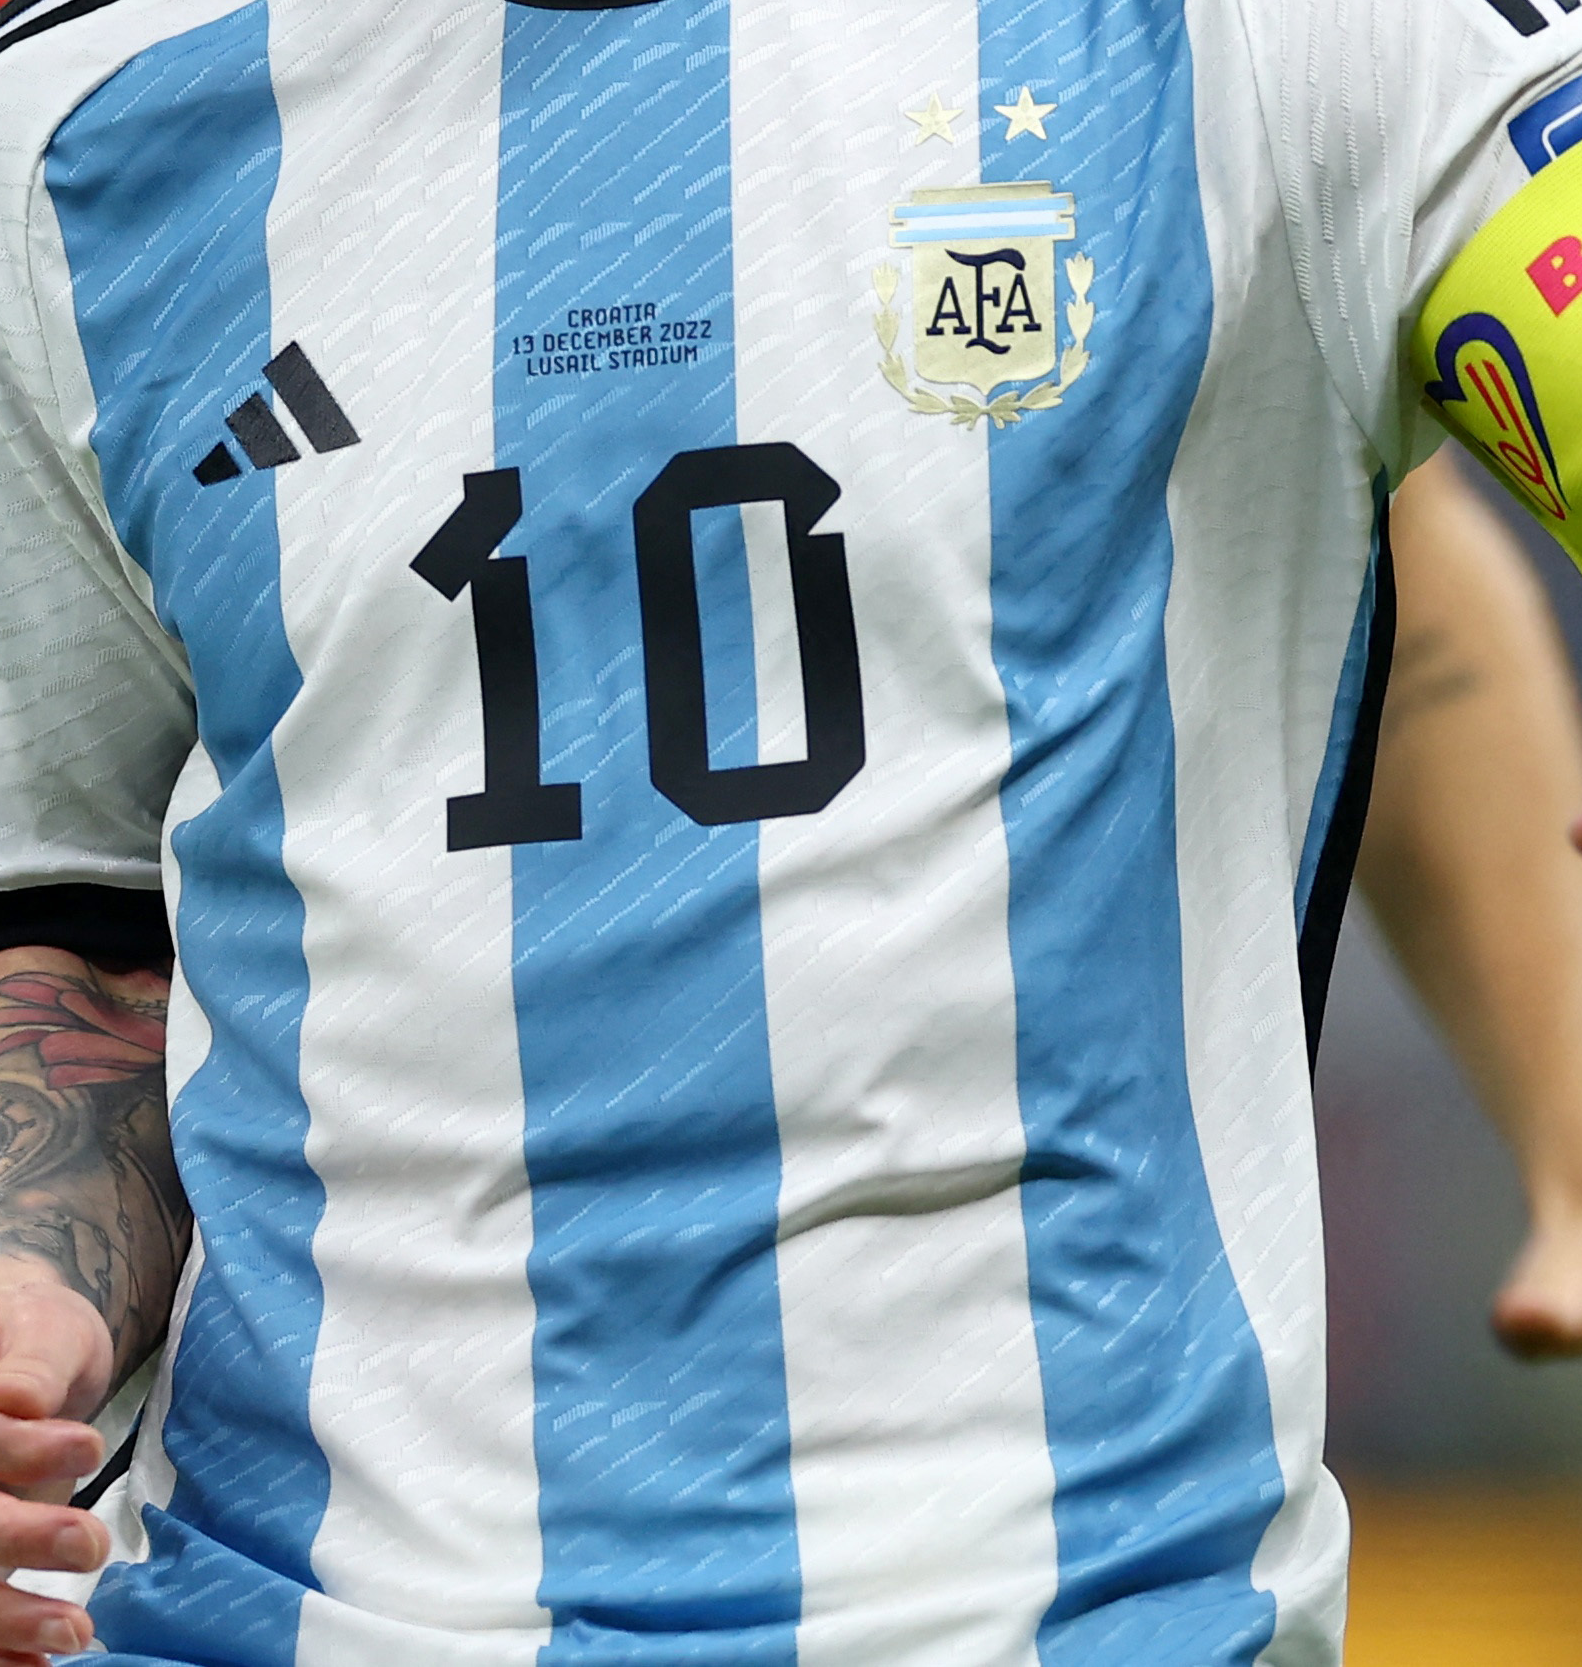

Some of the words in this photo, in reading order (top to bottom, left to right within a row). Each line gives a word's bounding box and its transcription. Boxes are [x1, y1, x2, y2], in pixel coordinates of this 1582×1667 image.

[567, 302, 657, 328] CROATIA
[925, 247, 1042, 355] AFA
[512, 335, 535, 356] 13
[543, 325, 653, 353] DECEMBER
[659, 320, 712, 343] 2022
[527, 354, 602, 376] LUSAIL
[608, 345, 698, 370] STADIUM
[409, 441, 866, 852] 10
